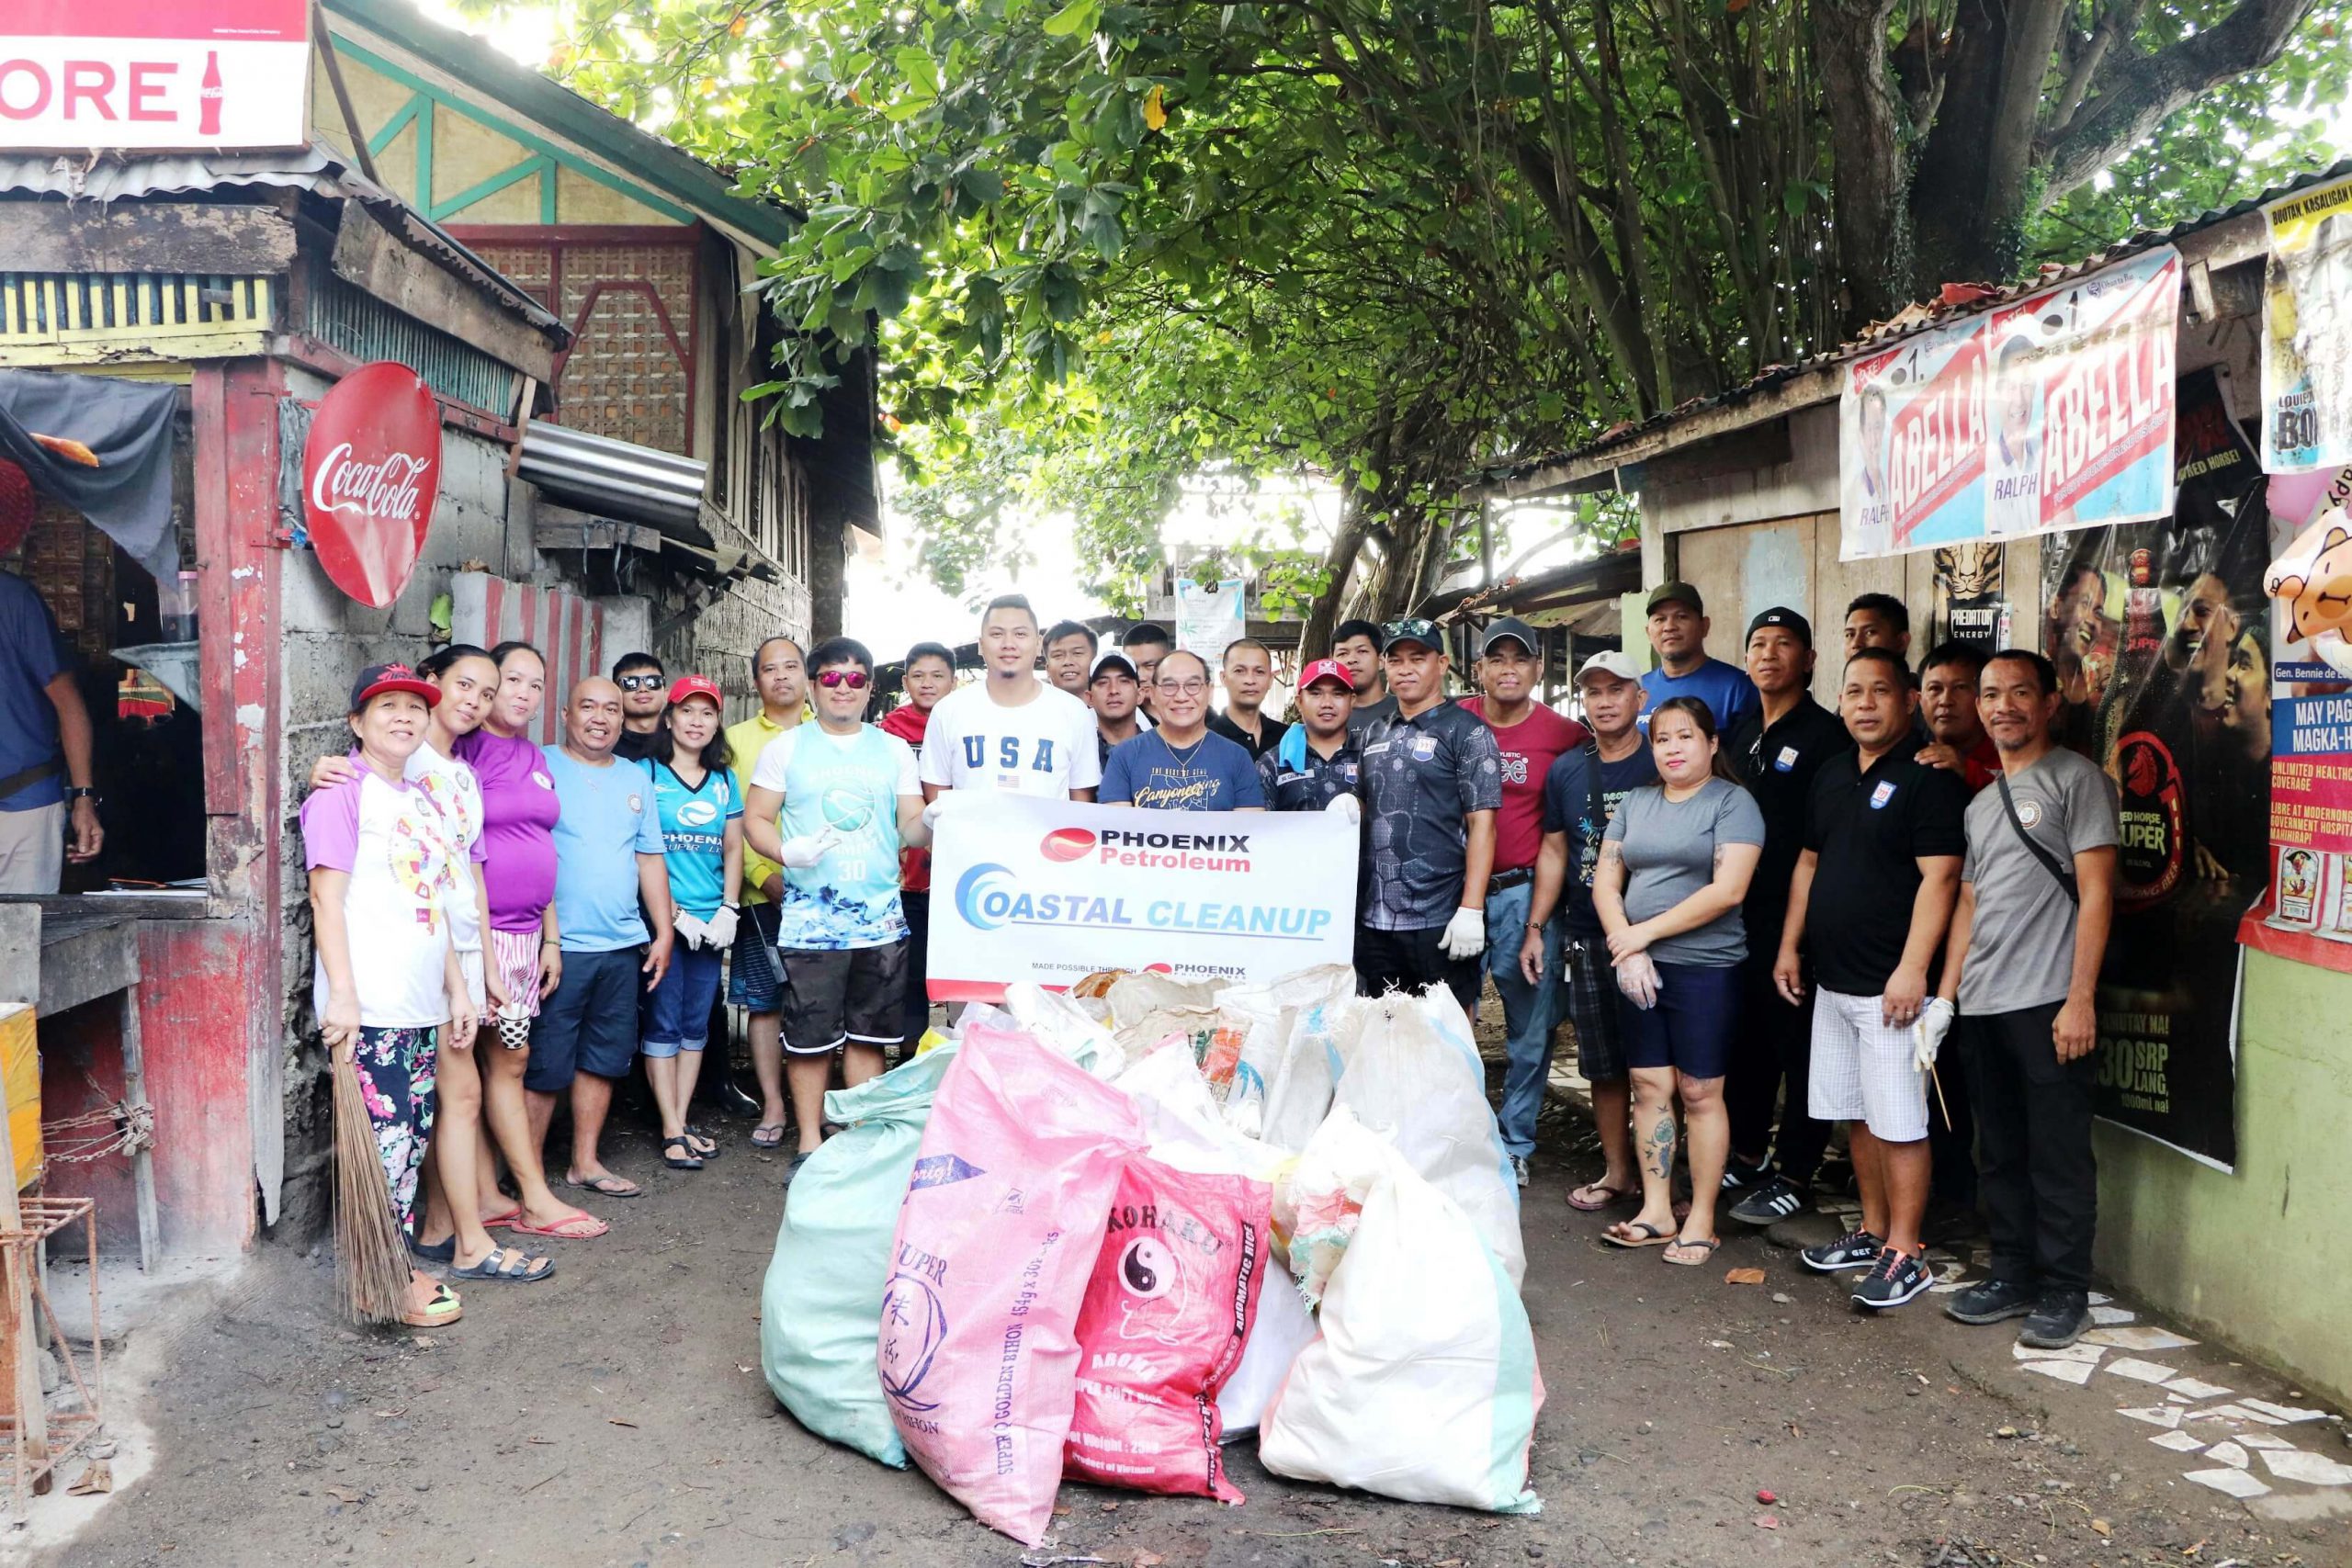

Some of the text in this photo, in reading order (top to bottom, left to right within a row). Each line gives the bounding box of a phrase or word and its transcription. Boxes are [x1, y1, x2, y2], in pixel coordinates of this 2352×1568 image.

[2304, 186, 2349, 215] KASALIGAN
[2043, 303, 2174, 497] ABELLA
[1891, 355, 1984, 520] ABELLA
[2207, 448, 2241, 470] HORSE!
[312, 443, 432, 520] Coca-Cola
[1994, 472, 2038, 501] RALPH
[1951, 609, 1993, 632] PREDATOR
[1954, 630, 1989, 638] ENERGY
[2276, 668, 2293, 678] Gen.
[2295, 668, 2324, 678] Bennie
[2324, 668, 2335, 679] de
[2295, 702, 2324, 726] MAY
[2272, 761, 2313, 777] UNLIMITED
[2272, 775, 2311, 792] COVERAGE
[2133, 812, 2160, 824] HORSE
[2271, 801, 2290, 816] LIBRE
[2292, 805, 2301, 817] AT
[2269, 827, 2312, 845] MAHIHIRAP!
[2270, 815, 2318, 832] GOVERNMENT
[1100, 829, 1250, 853] PHOENIX
[2120, 824, 2166, 855] UPER
[1100, 847, 1250, 874] Petroleum
[2161, 862, 2178, 890] BEER
[1147, 900, 1332, 936] CLEANUP
[1057, 964, 1095, 973] POSSIBLE
[1099, 965, 1137, 975] THRGH
[1174, 964, 1246, 976] PHOENIX
[2135, 1041, 2168, 1071] SRP
[899, 1240, 948, 1288] UPER
[1236, 1224, 1257, 1332] AROMATIC RICE
[1003, 1325, 1023, 1364] BIHON
[995, 1365, 1014, 1421] GOLDEN
[998, 1433, 1013, 1475] SUPER
[1083, 1433, 1122, 1452] Weight
